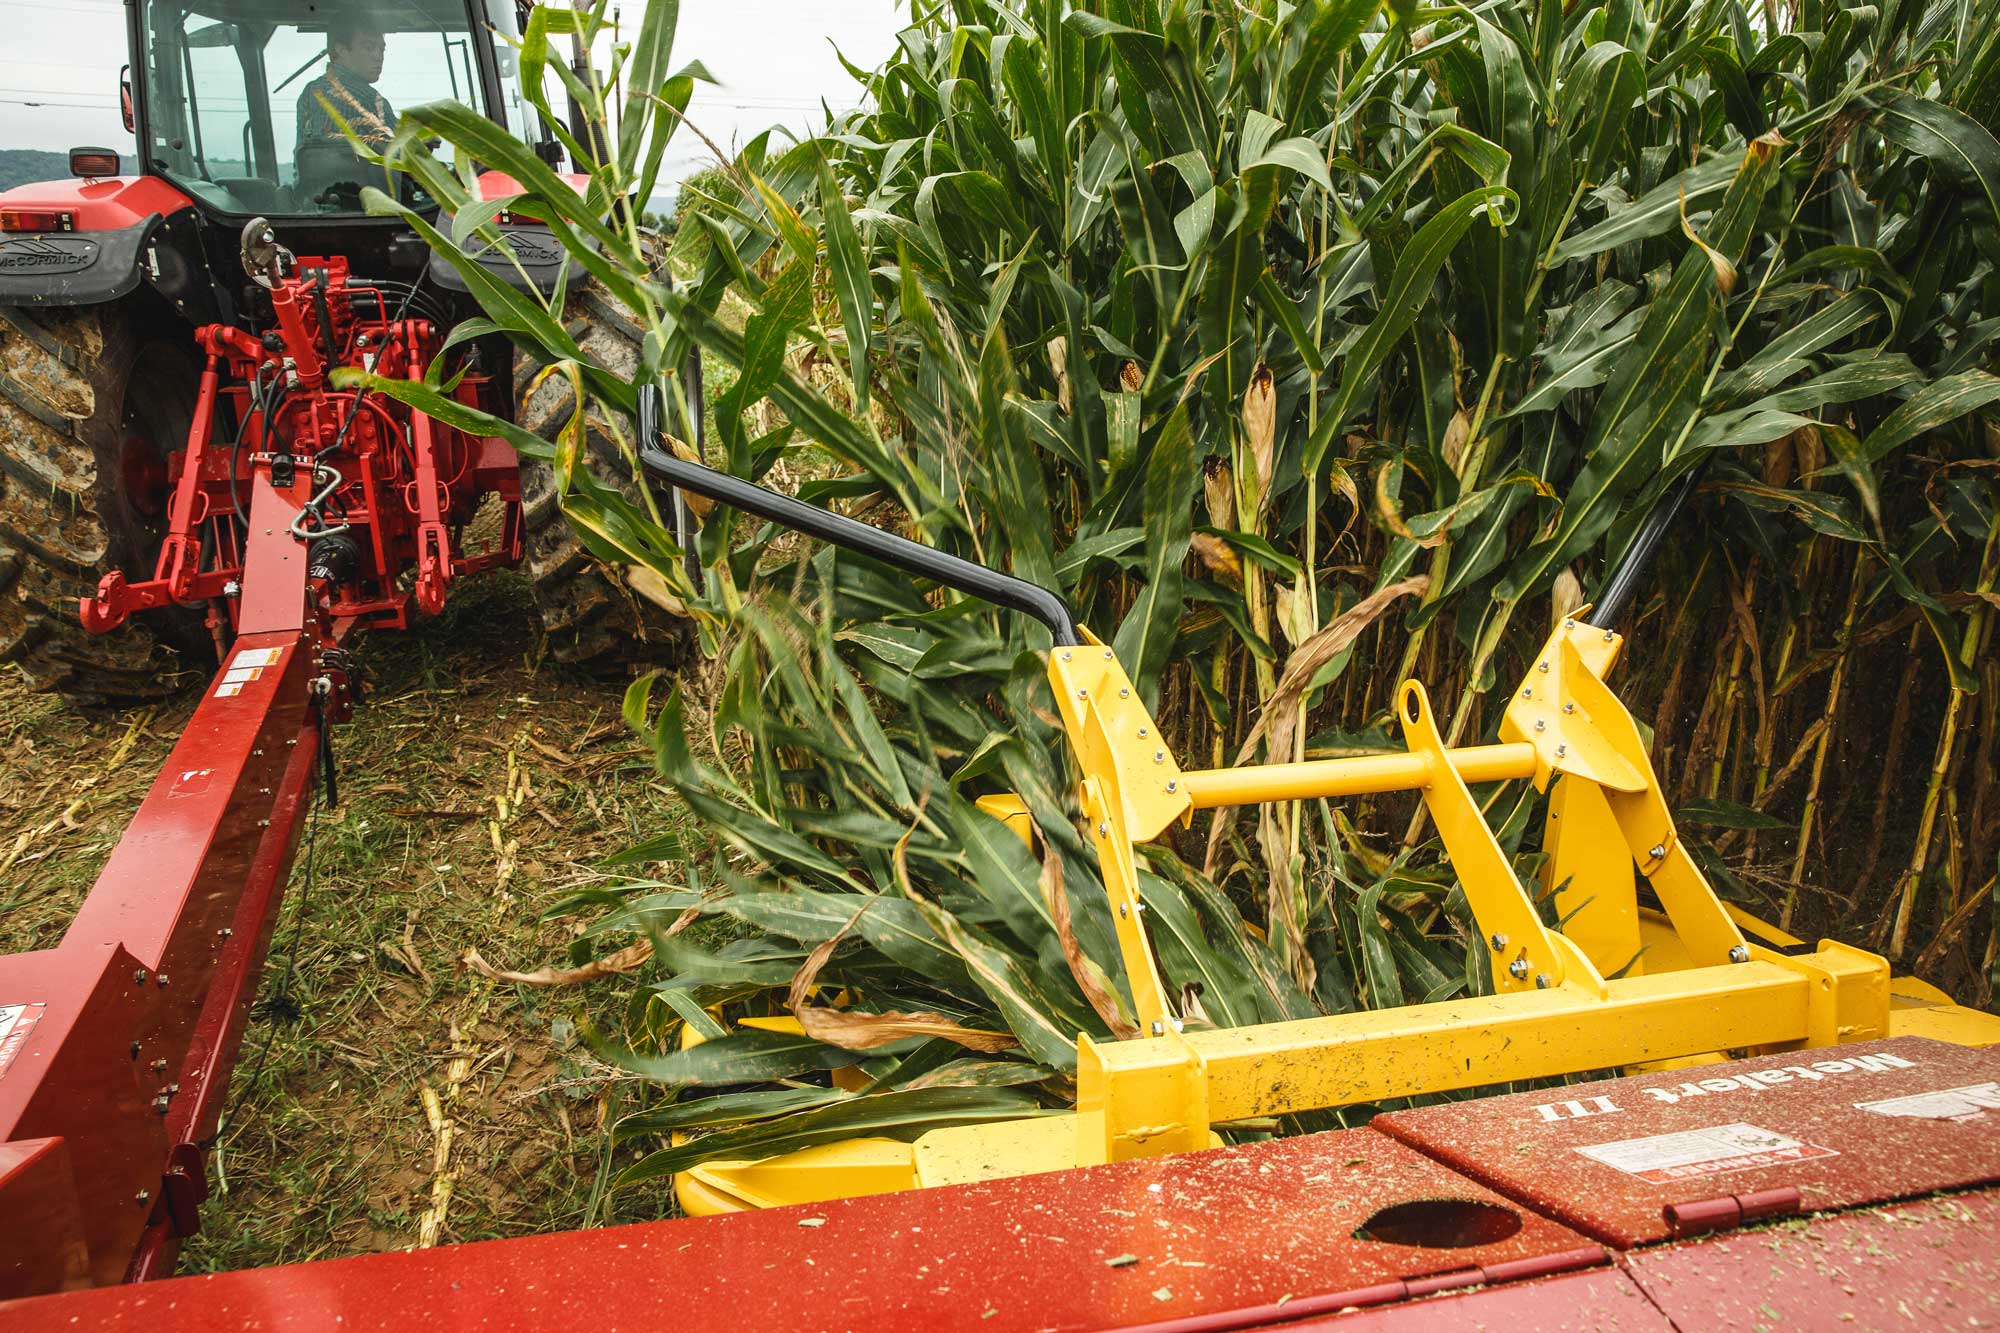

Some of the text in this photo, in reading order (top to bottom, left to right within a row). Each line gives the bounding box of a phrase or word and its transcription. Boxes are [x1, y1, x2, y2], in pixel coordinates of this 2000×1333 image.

[1641, 1053, 1916, 1104] Metalert
[1530, 1095, 1625, 1123] III
[1663, 1154, 1774, 1177] DANGER
